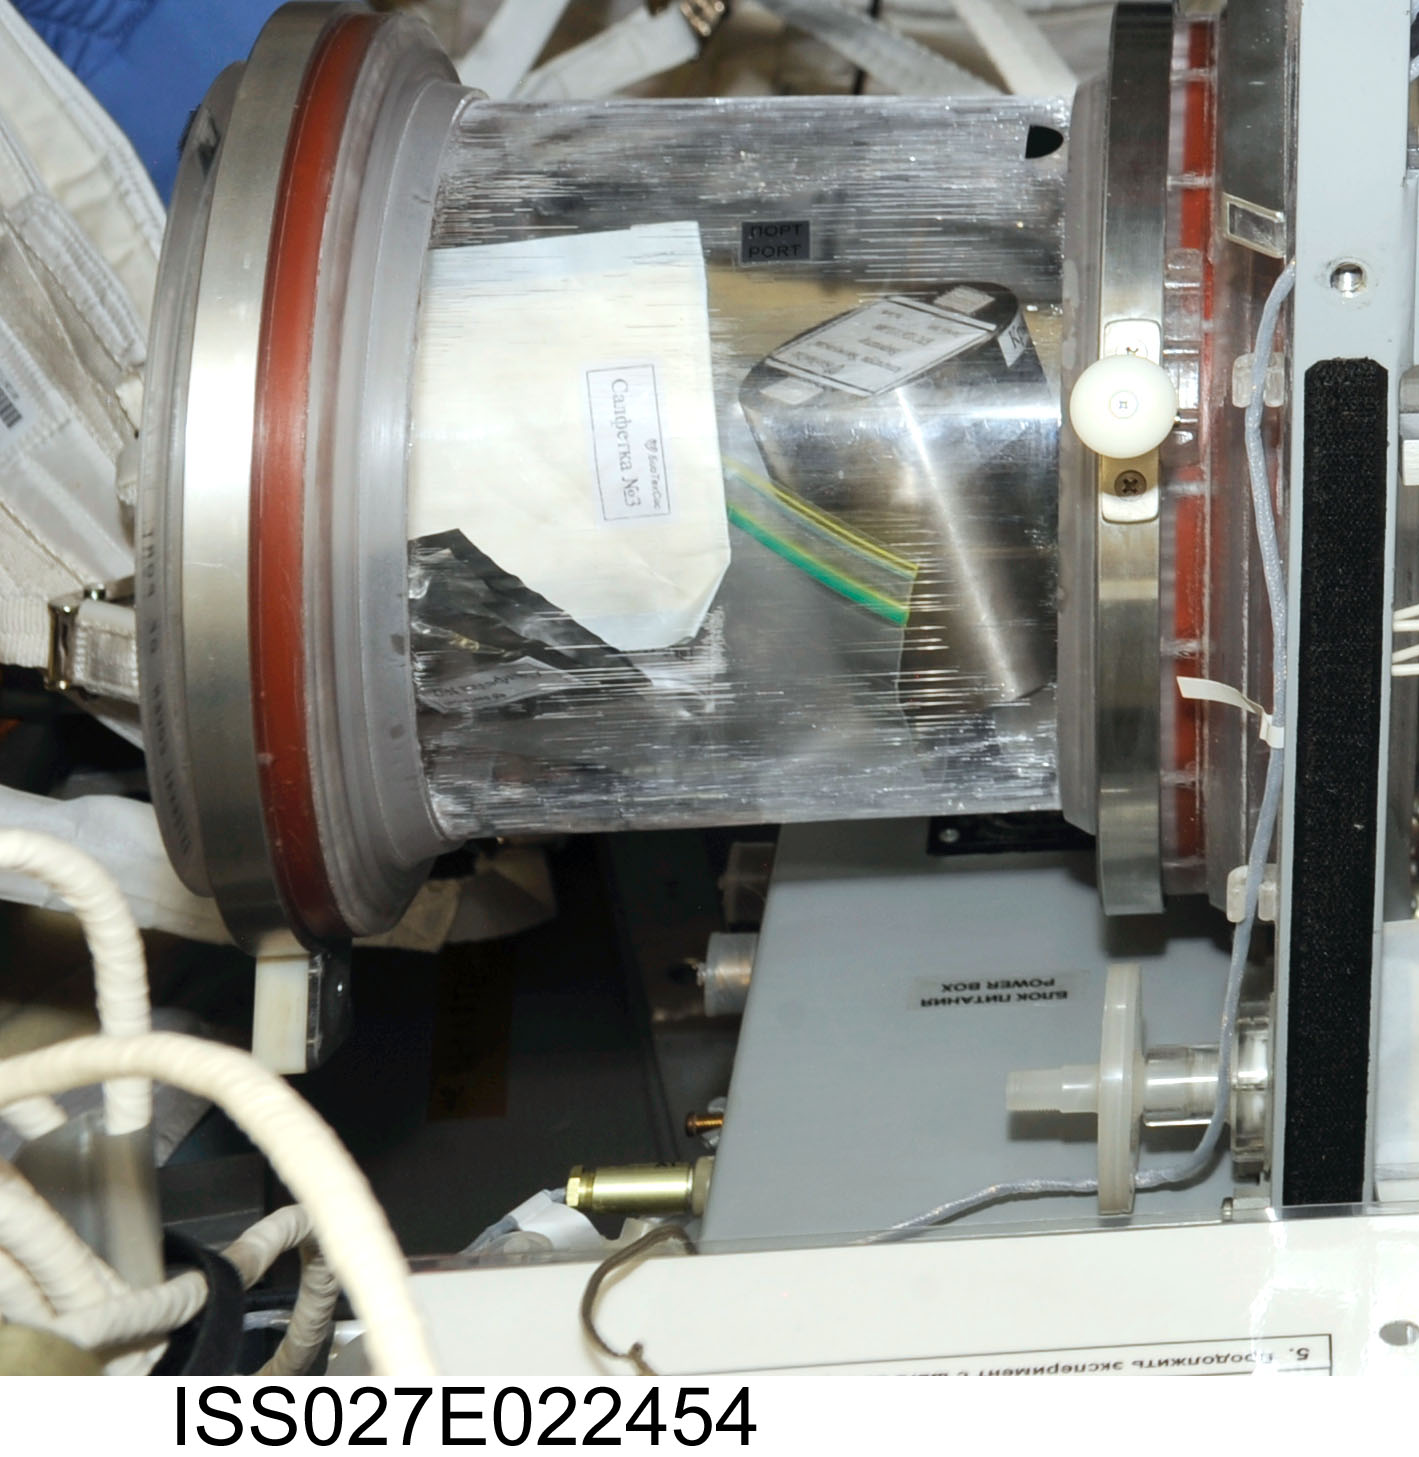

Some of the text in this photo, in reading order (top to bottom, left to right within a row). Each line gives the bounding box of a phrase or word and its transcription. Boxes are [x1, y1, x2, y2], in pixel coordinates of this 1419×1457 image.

[750, 224, 802, 237] ПОРТ
[749, 244, 801, 258] PORT
[610, 376, 635, 471] Салфетка
[941, 978, 1055, 992] POWER BOX
[920, 991, 1068, 1007] БЛОК ПИТАНИЯ
[1290, 1348, 1310, 1361] 5.
